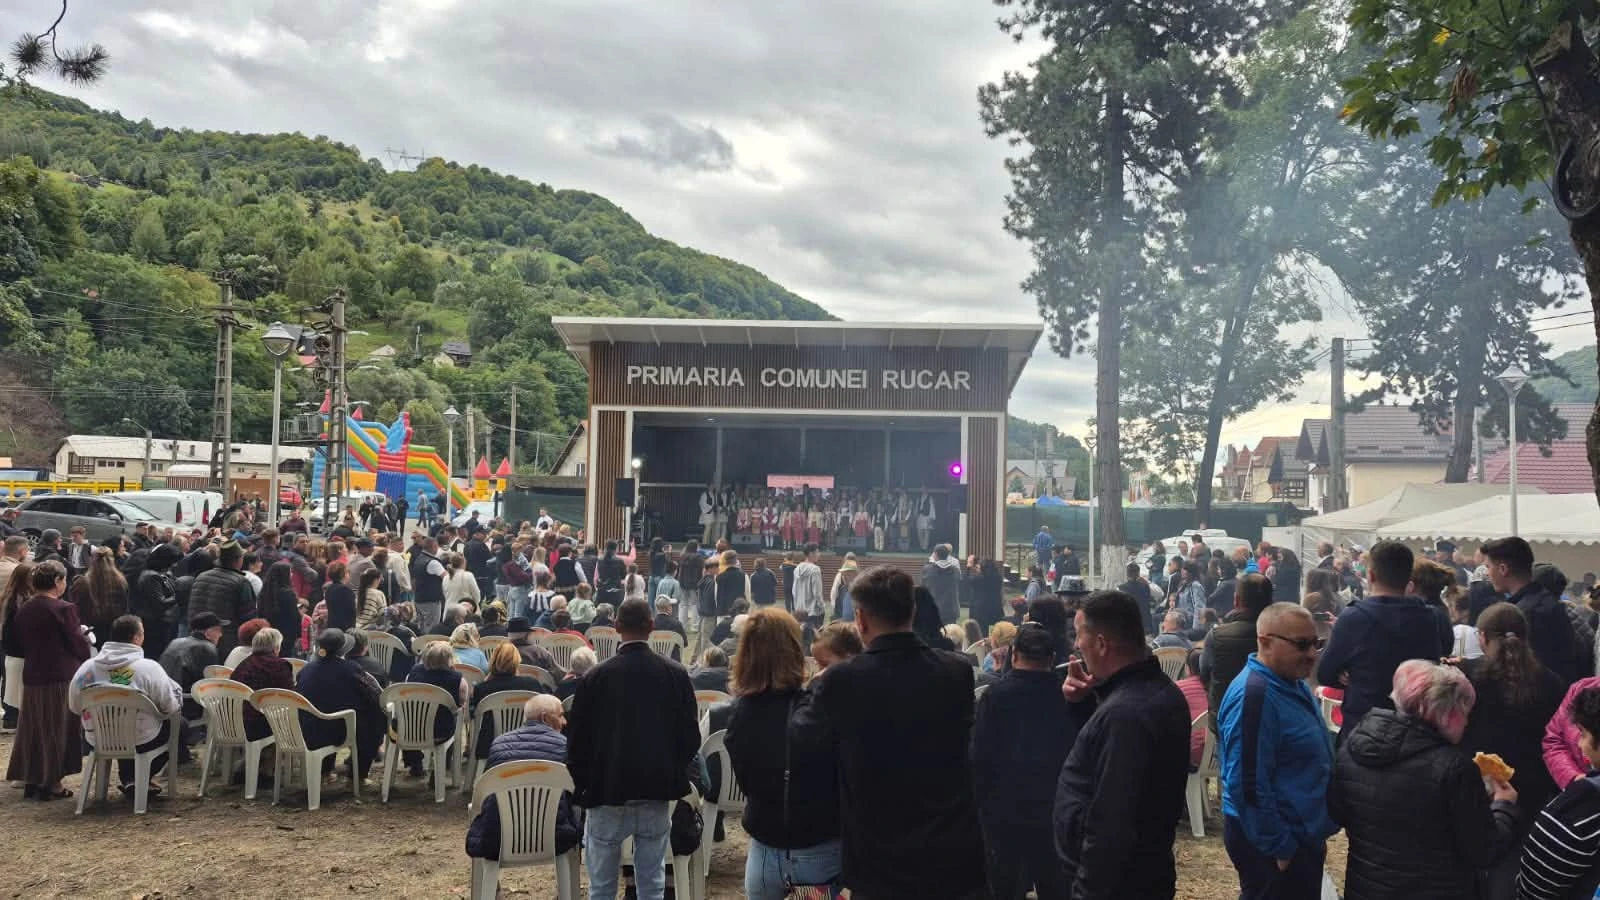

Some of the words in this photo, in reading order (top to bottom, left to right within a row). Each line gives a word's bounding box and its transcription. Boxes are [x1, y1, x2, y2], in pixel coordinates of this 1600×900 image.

[627, 365, 745, 387] PRIMARIA
[761, 367, 868, 389] COMUNEI
[882, 369, 971, 391] RUCAR
